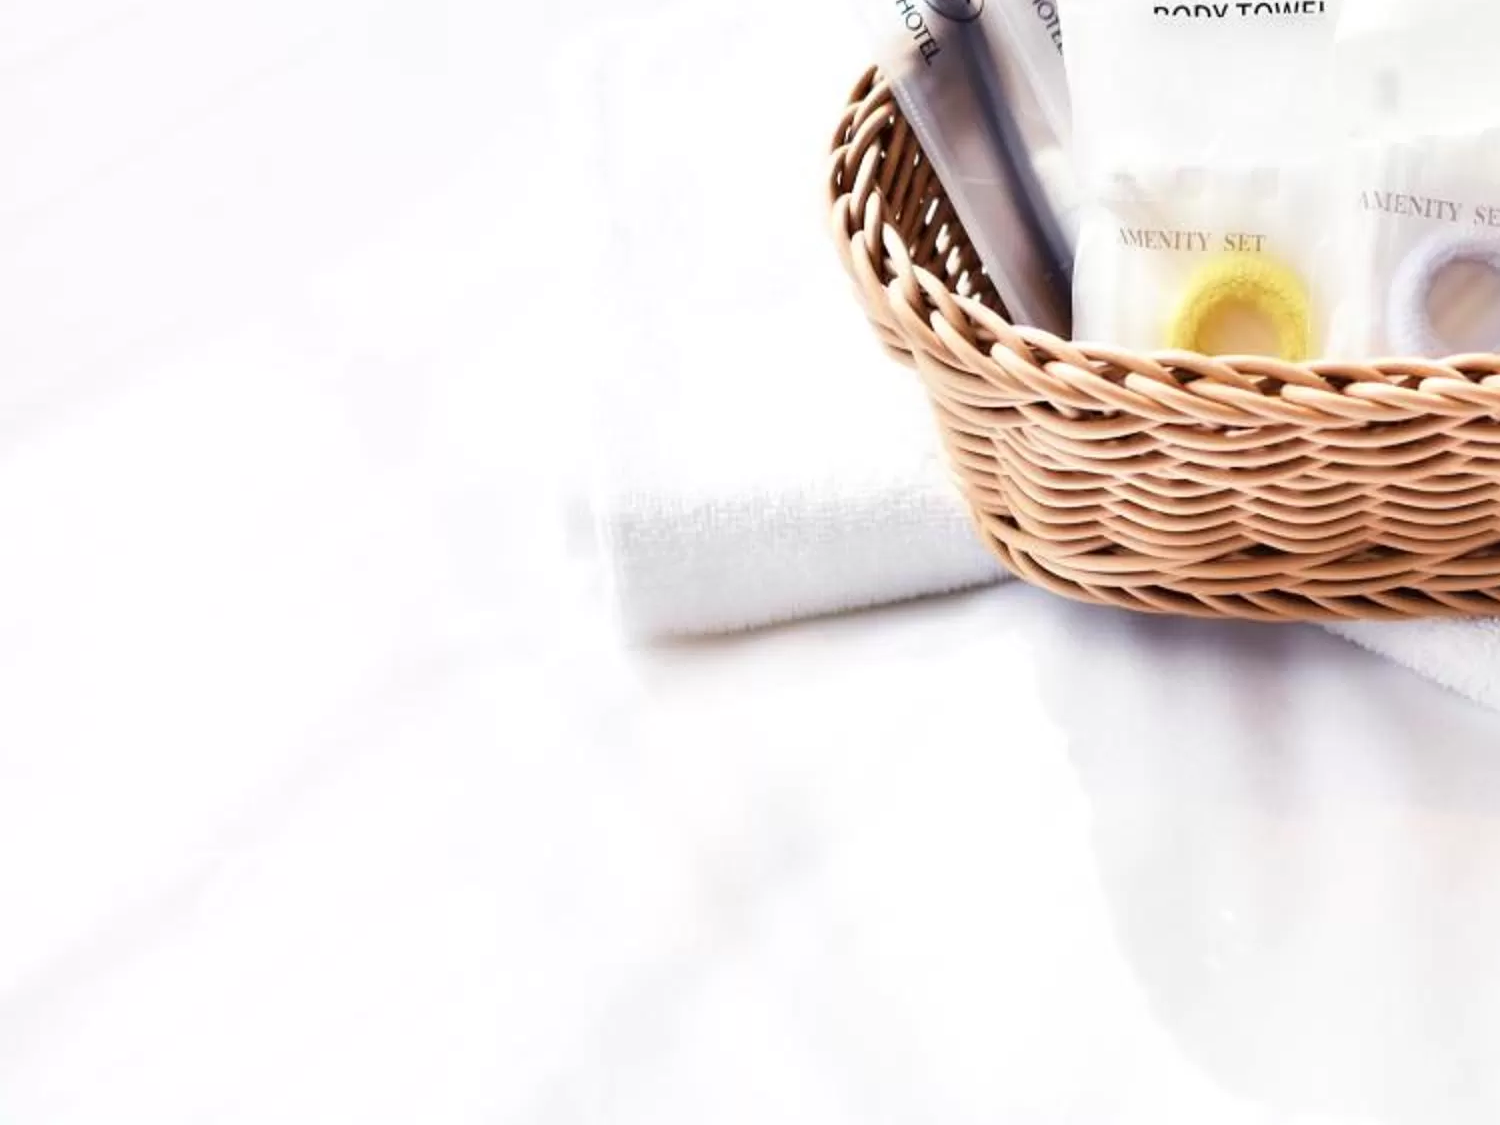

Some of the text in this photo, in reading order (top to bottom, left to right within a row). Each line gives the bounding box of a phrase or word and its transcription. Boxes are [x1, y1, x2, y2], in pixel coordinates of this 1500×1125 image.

[1360, 189, 1463, 222] AMENITY
[1117, 226, 1267, 253] AMENITY SET
